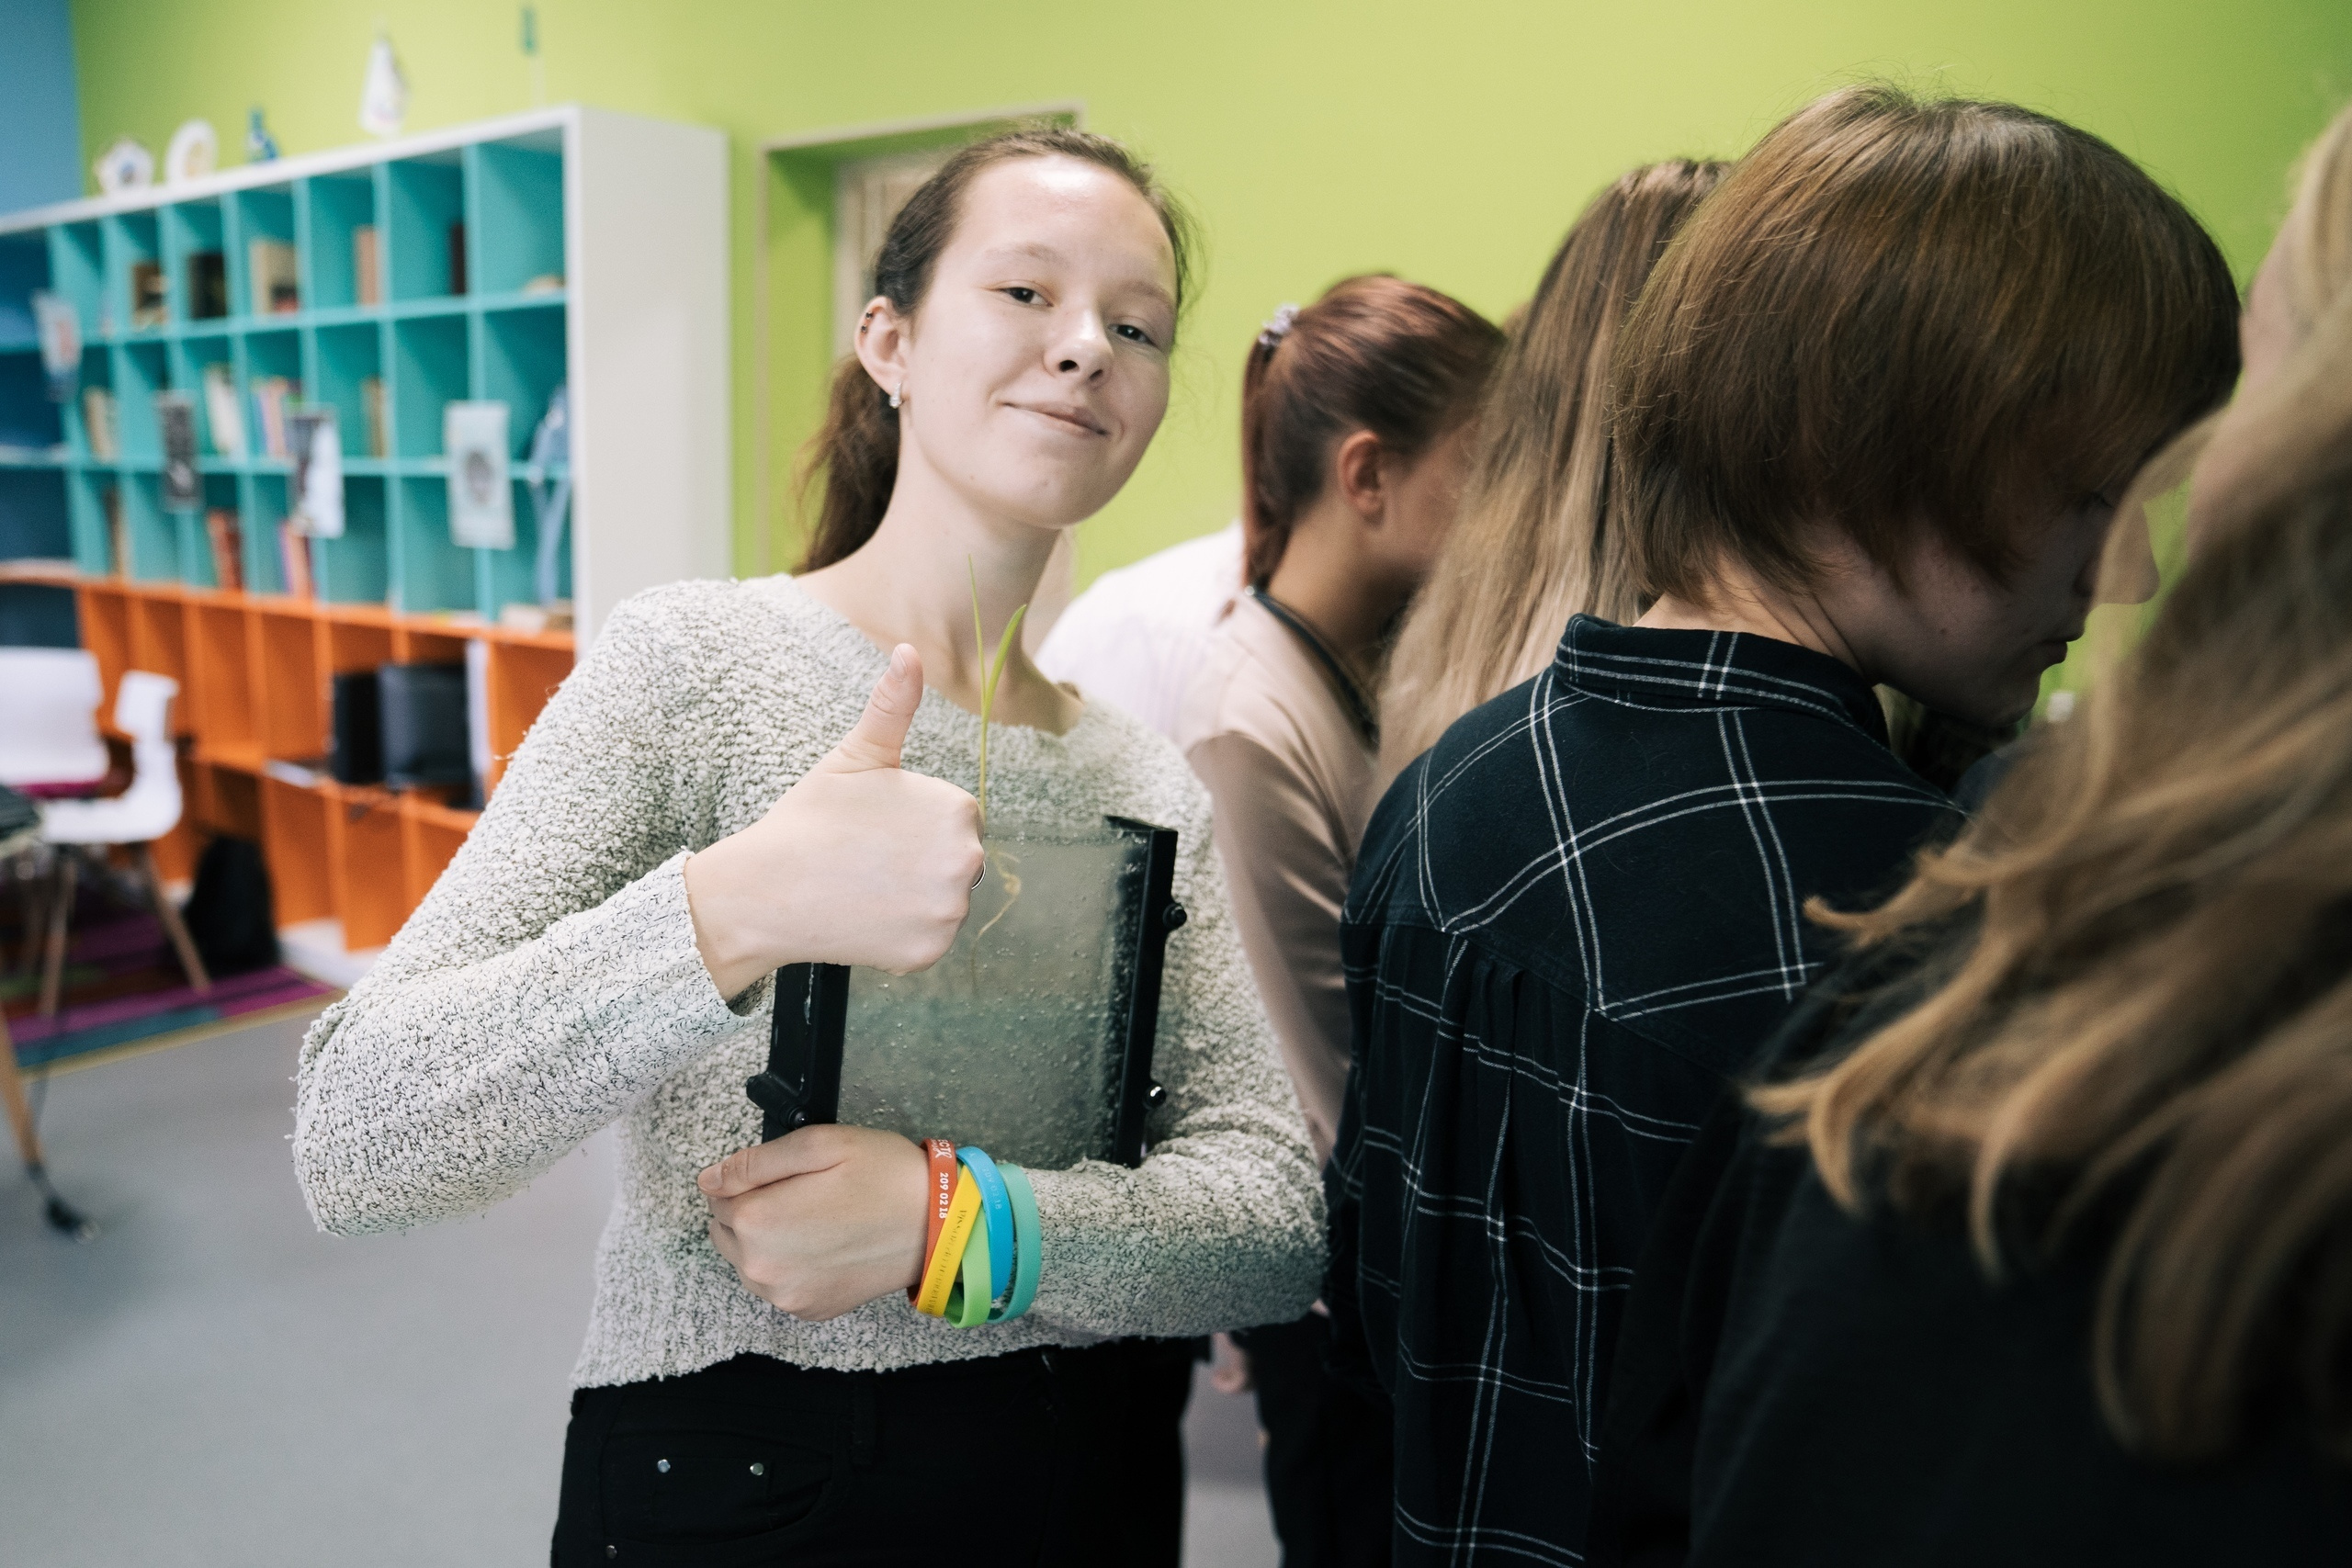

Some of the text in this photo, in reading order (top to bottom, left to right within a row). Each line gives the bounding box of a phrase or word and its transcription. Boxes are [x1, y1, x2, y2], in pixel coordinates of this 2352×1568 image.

[939, 1172, 949, 1219] 209 02 18
[994, 1199, 1002, 1210] 18
